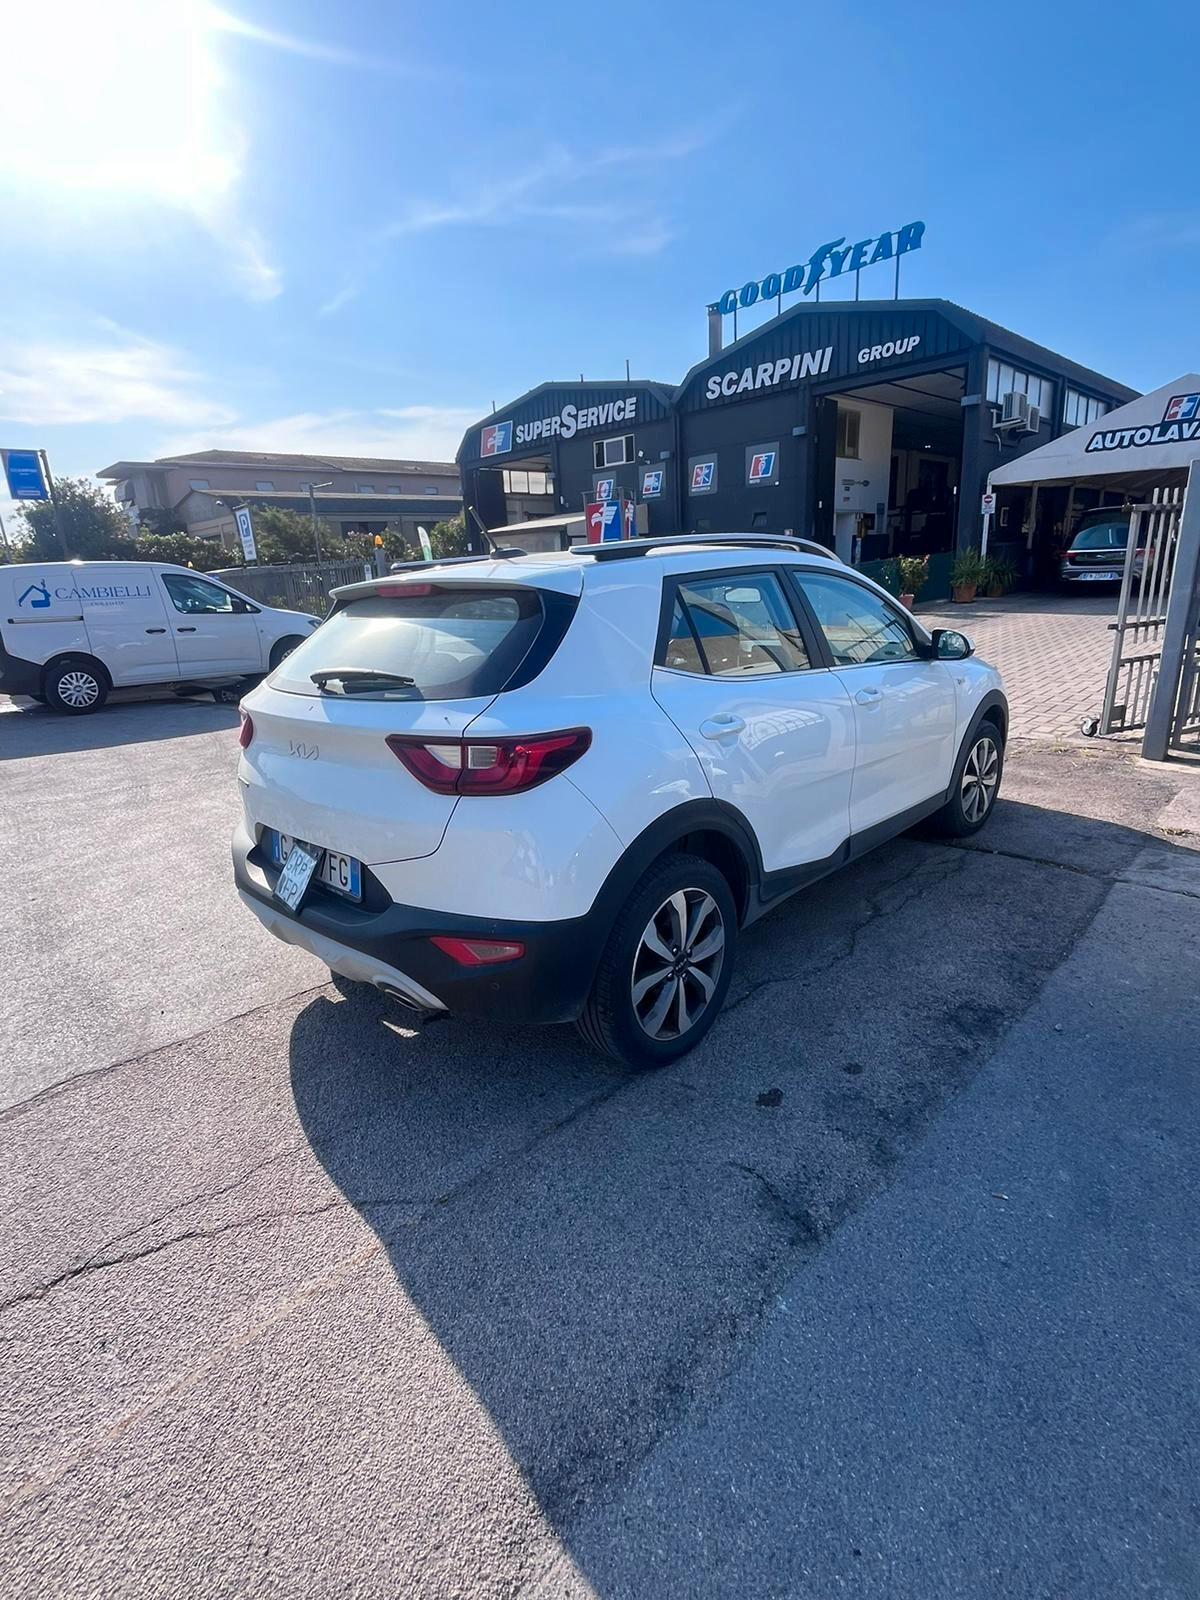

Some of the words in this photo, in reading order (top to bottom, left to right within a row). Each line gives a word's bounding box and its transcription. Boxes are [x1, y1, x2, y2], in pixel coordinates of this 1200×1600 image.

[719, 221, 926, 315] GOODYEAR
[705, 347, 833, 400] SCARPINI
[857, 336, 921, 364] GROUP
[515, 397, 637, 444] SUPERSERVICE
[54, 586, 152, 599] CAMBIELLI
